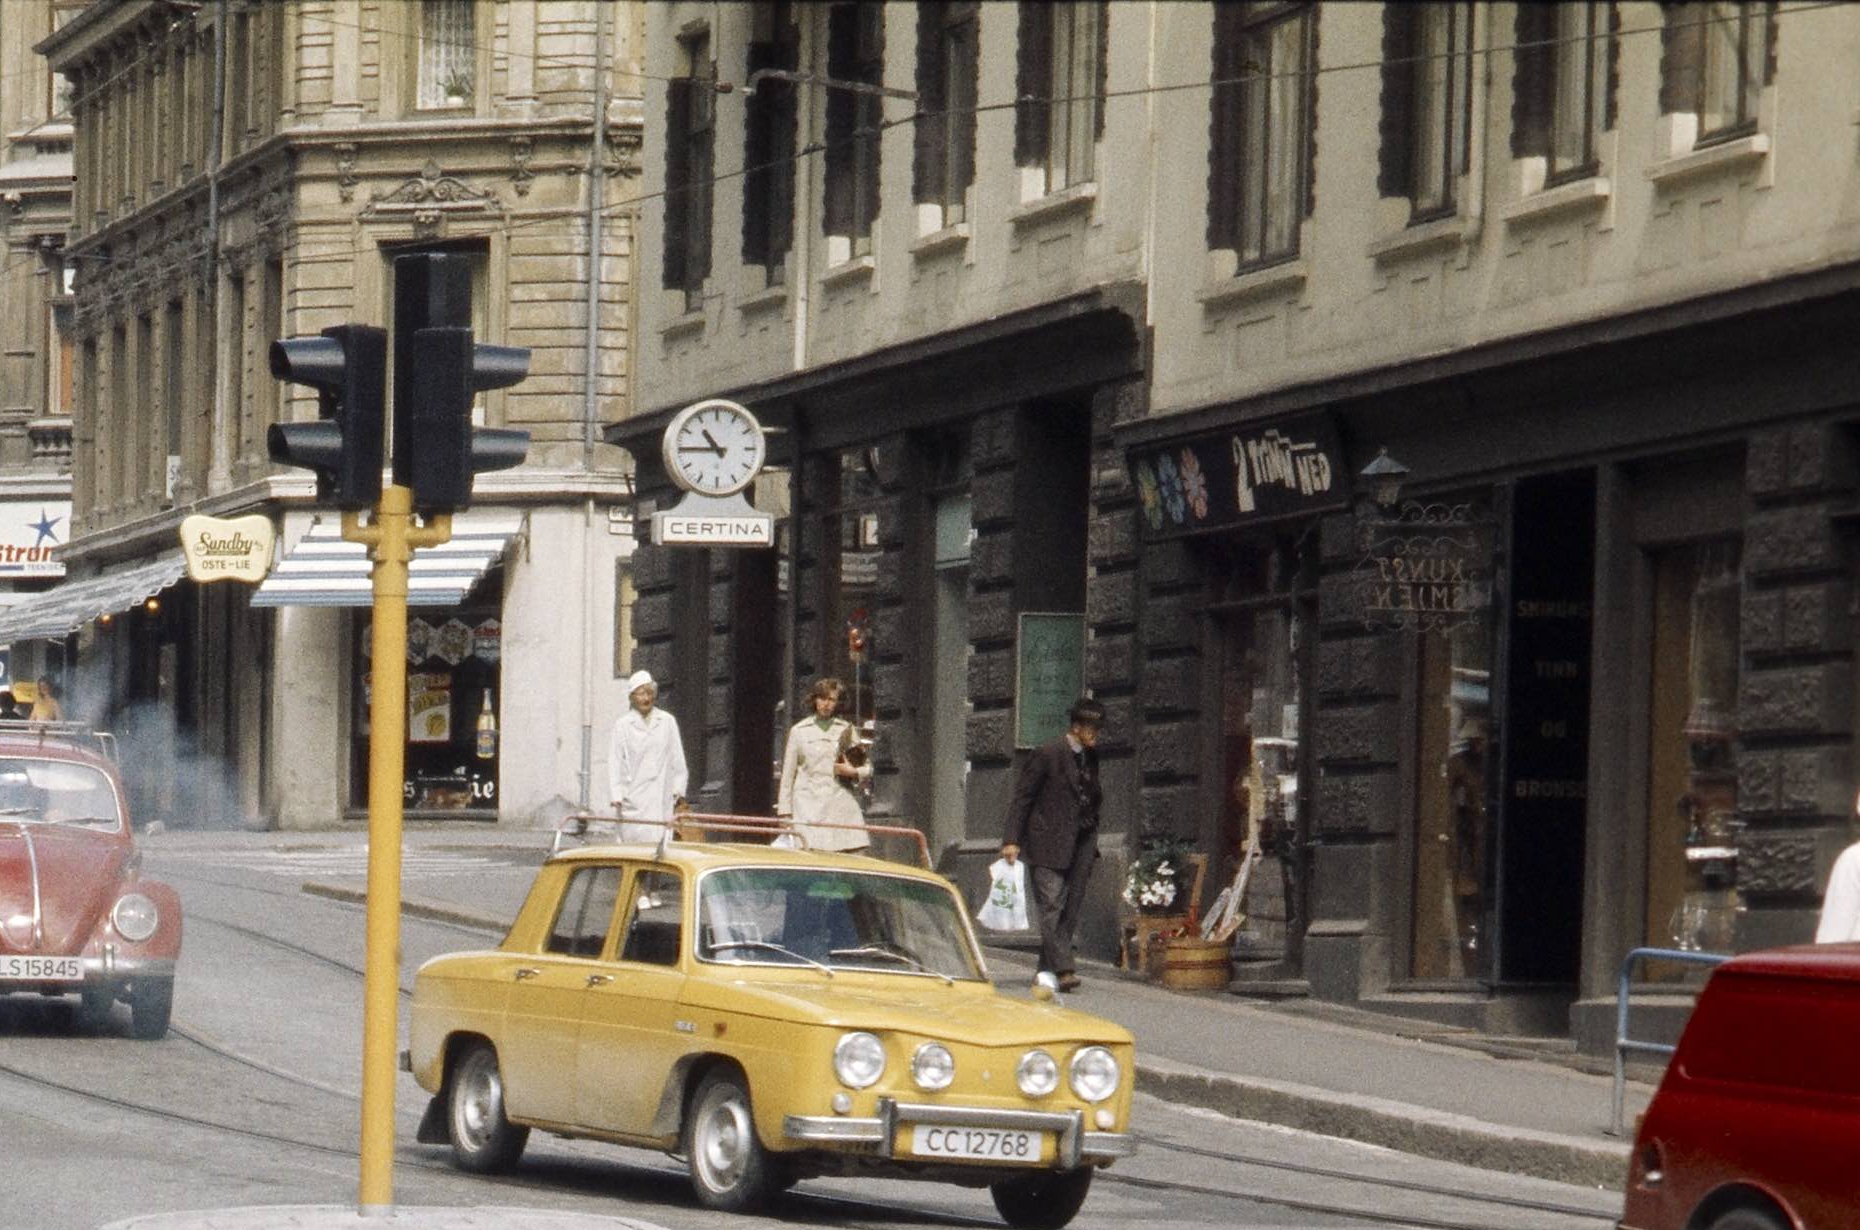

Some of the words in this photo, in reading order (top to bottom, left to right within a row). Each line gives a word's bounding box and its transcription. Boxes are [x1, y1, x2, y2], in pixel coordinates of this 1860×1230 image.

[670, 522, 763, 535] CERTINA
[199, 532, 253, 551] Sundby
[926, 1128, 1029, 1156] CC12768
